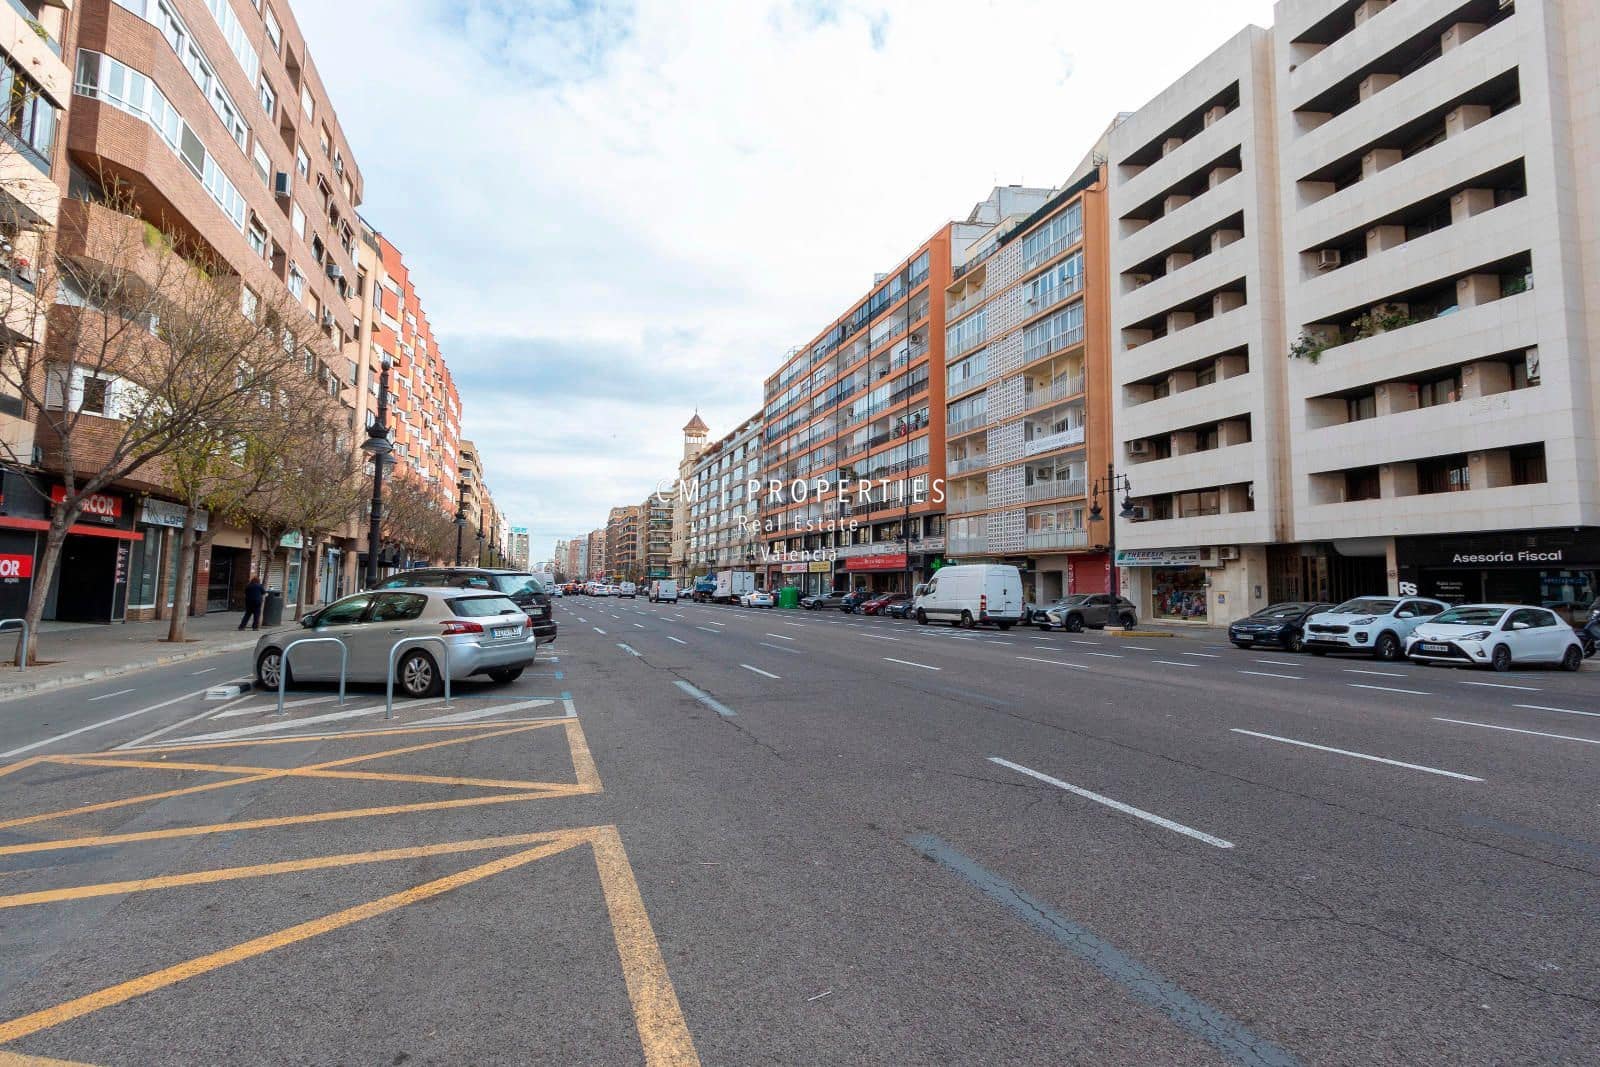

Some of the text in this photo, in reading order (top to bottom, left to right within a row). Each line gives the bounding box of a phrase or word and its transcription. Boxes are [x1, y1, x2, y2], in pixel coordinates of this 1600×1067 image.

[1452, 549, 1562, 563] Asesoría Fiscal
[1399, 581, 1418, 596] RS
